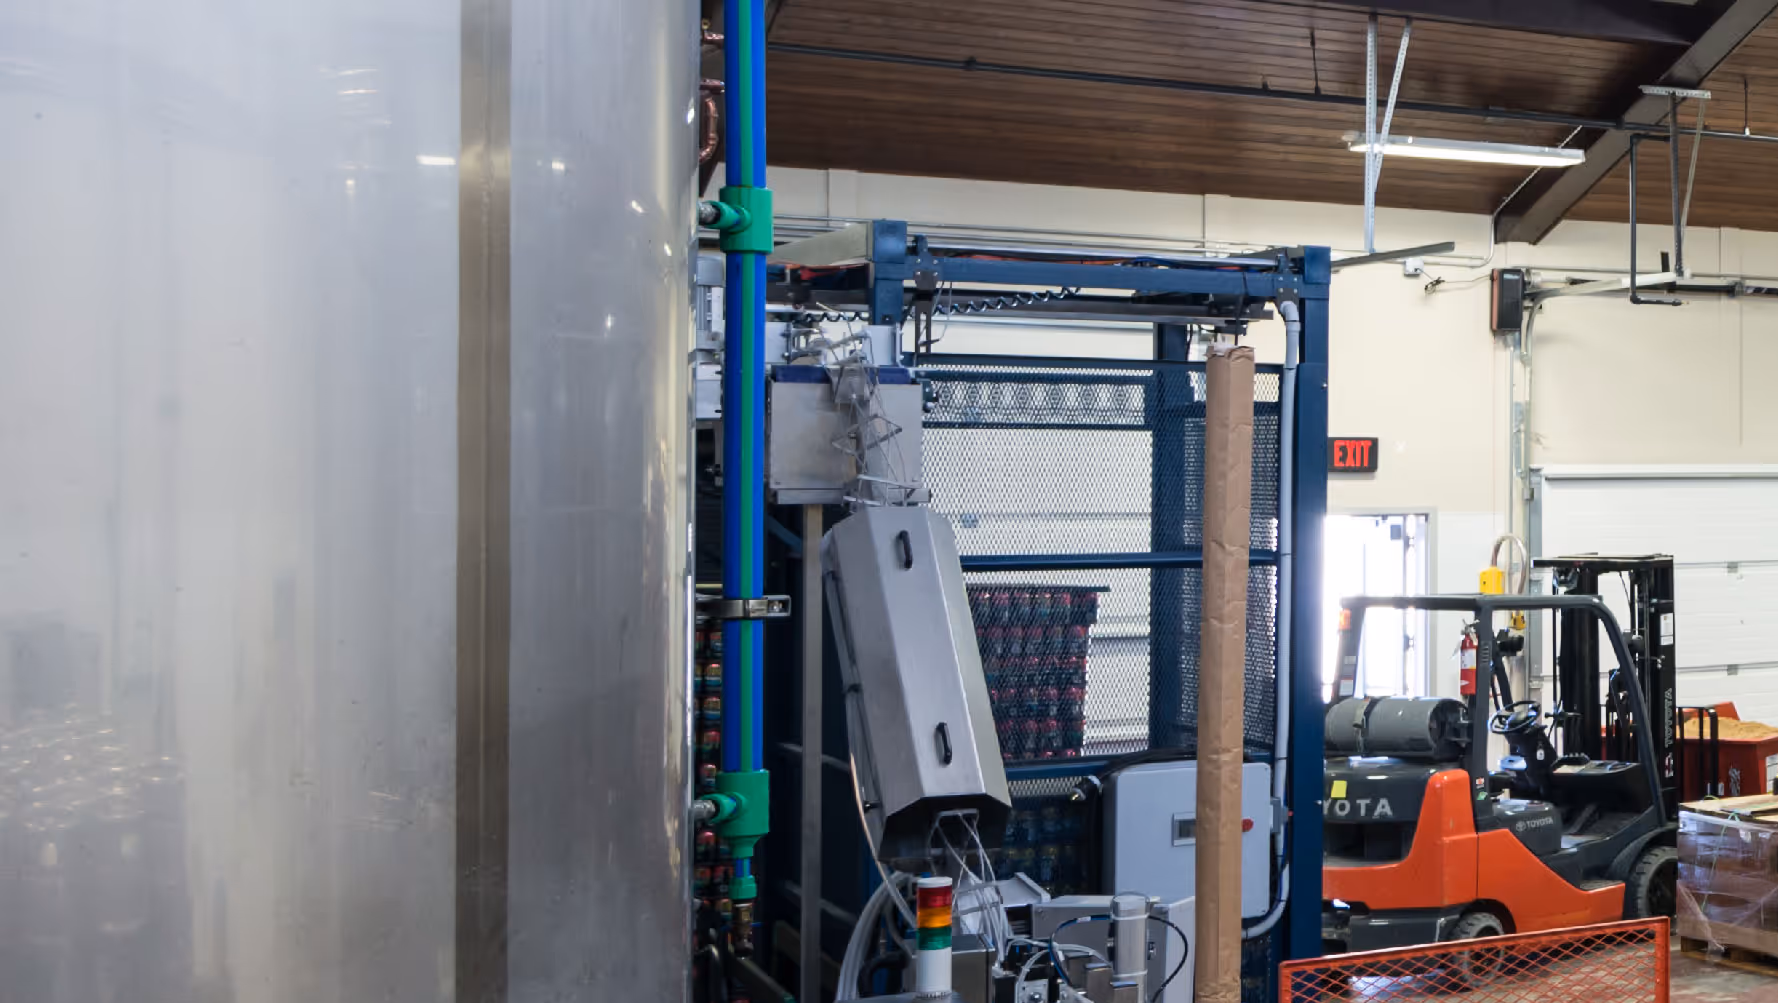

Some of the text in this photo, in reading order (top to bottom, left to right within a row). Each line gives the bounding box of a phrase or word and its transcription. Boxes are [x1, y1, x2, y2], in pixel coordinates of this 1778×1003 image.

[1334, 440, 1372, 467] EXIT
[1323, 798, 1393, 818] YOTA
[1526, 816, 1554, 829] TOYOTA
